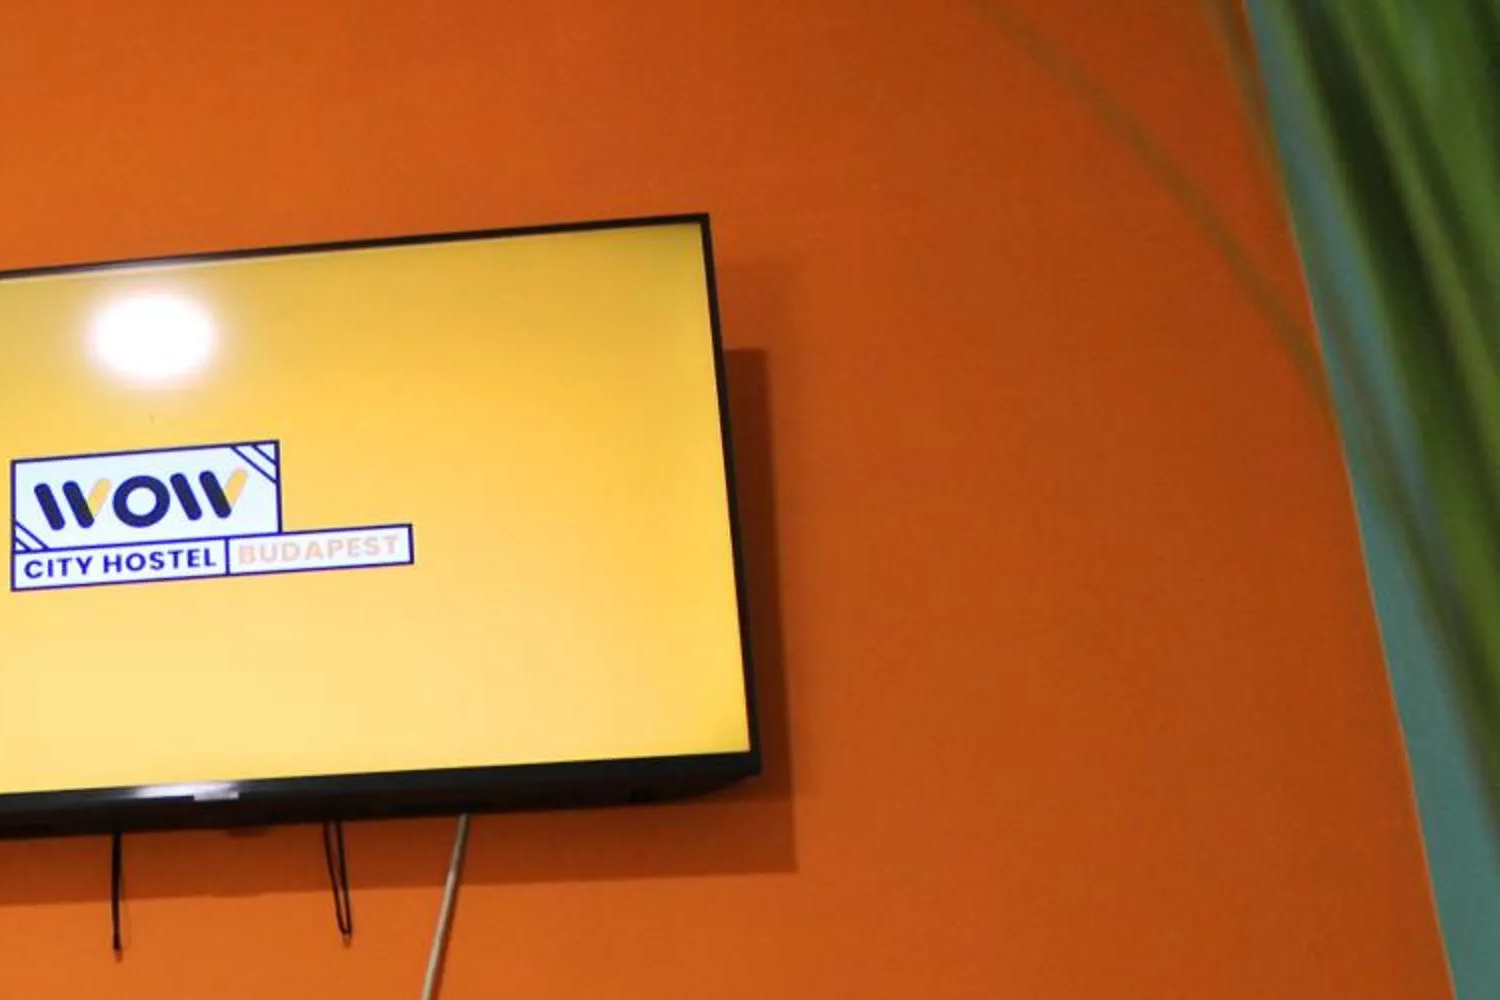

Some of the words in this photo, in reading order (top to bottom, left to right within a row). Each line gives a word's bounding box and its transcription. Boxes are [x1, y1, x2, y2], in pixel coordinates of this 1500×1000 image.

[33, 467, 248, 531] WOW
[23, 555, 93, 579] CITY
[103, 547, 217, 574] HOSTEL
[238, 534, 399, 566] BUDAPEST
